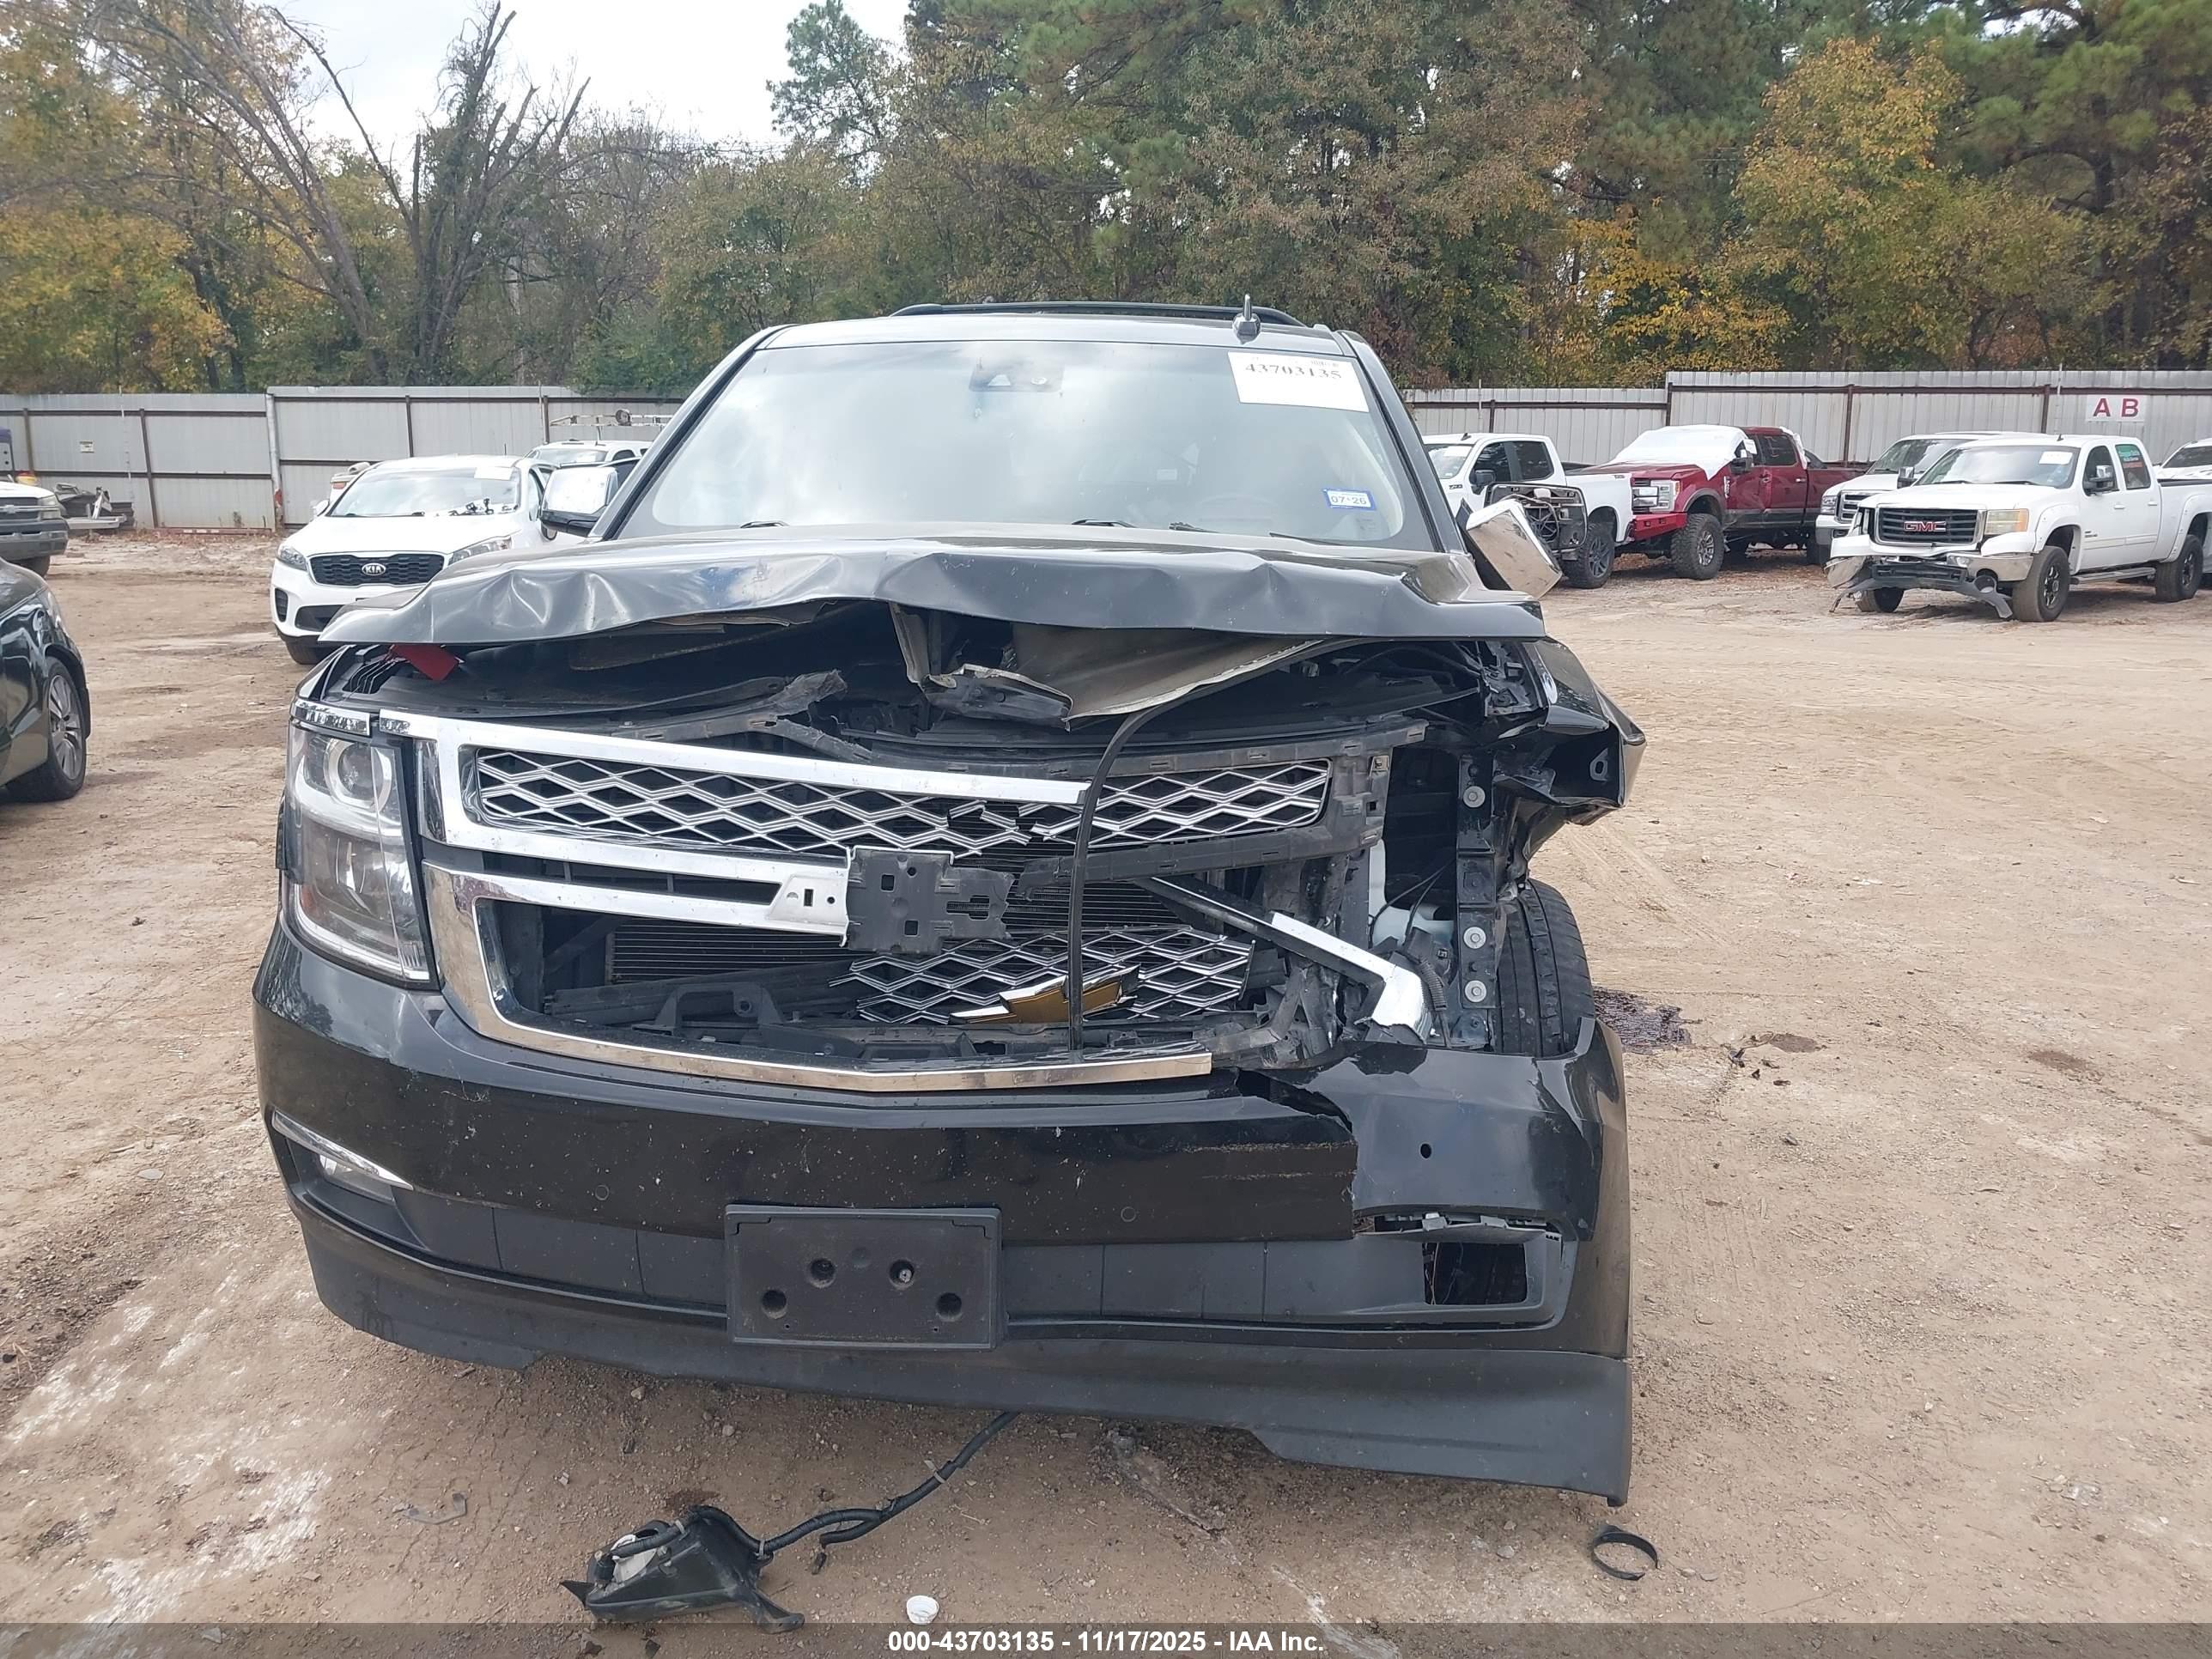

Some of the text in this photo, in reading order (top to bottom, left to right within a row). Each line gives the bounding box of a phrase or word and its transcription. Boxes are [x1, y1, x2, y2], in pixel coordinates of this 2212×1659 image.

[1244, 362, 1342, 380] 43703135
[2093, 398, 2139, 416] A B
[1904, 520, 1947, 532] GMC
